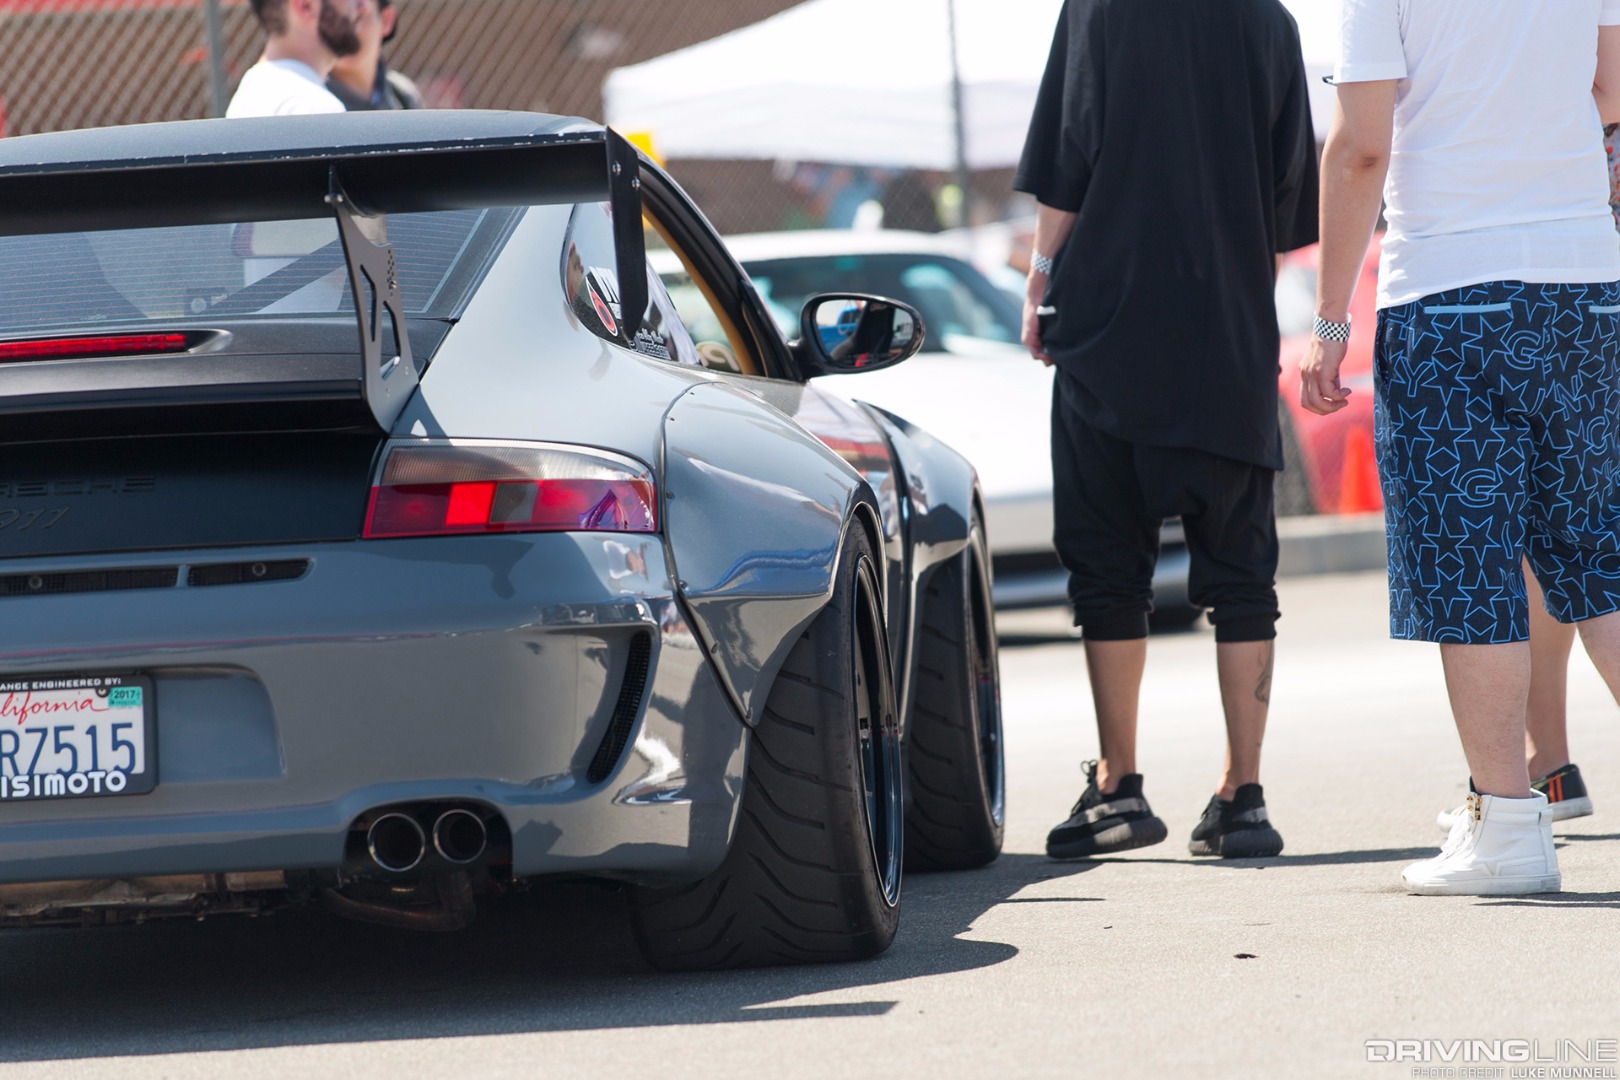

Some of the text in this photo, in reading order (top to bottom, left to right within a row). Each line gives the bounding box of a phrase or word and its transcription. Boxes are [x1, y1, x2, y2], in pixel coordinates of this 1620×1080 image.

[32, 678, 101, 689] ENGINEERED
[114, 689, 136, 699] 2017
[0, 691, 109, 726] lifornia
[0, 722, 136, 778] R7515
